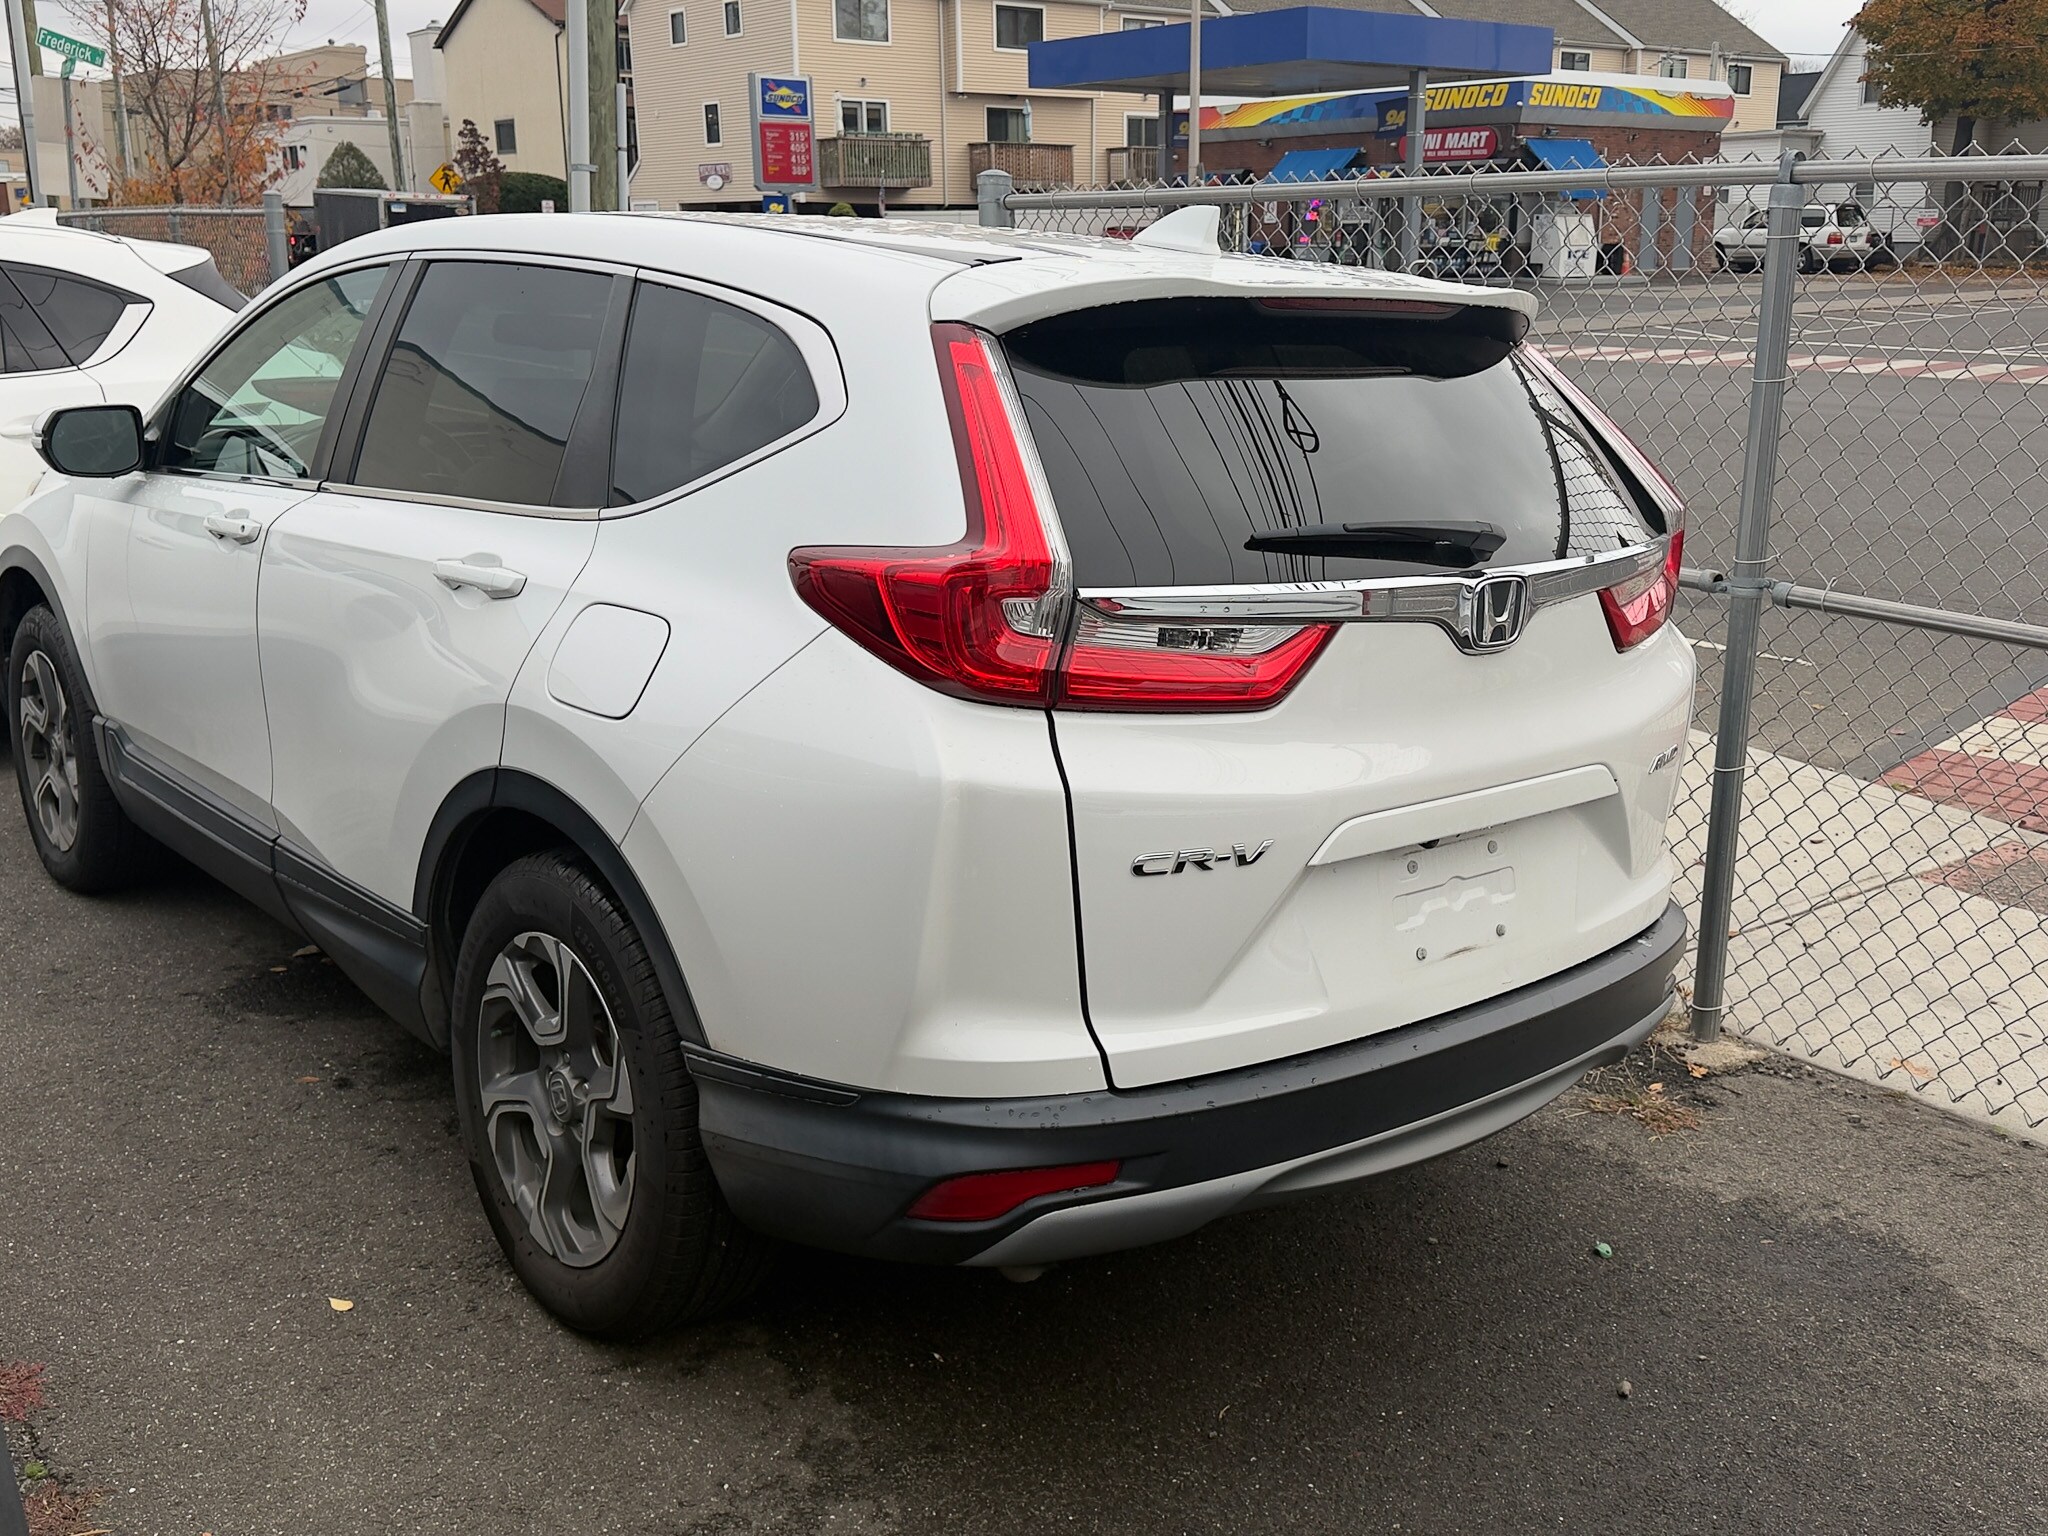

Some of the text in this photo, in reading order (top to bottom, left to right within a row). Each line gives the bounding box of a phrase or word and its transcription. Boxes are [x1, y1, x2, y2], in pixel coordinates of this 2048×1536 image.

[38, 29, 91, 61] Frederick
[767, 93, 803, 104] SUNOCO
[1425, 83, 1510, 111] SUNOCO
[1529, 83, 1602, 109] SUNOCO
[1386, 109, 1406, 127] 94
[1179, 121, 1189, 135] 9
[1445, 131, 1489, 149] MART
[1567, 249, 1588, 259] ICE
[1130, 838, 1275, 877] CR-V
